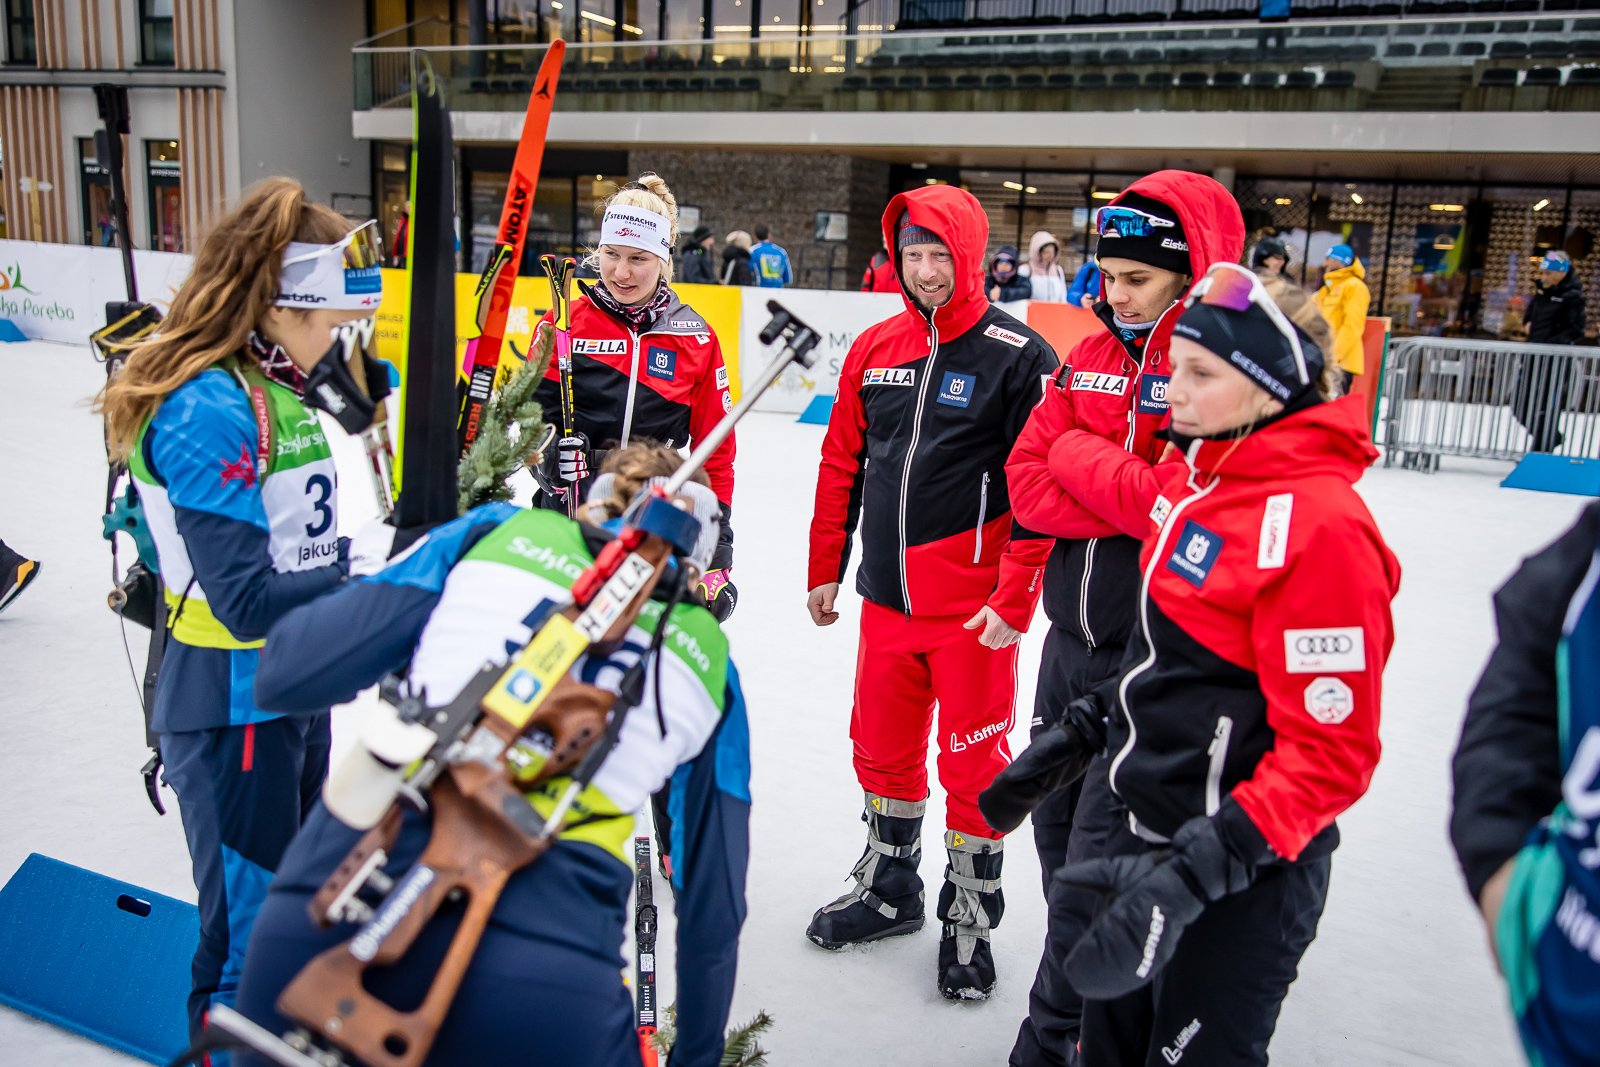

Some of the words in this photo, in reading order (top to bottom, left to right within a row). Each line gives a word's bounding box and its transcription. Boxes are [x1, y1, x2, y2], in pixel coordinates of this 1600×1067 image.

[504, 186, 527, 245] ATOM
[610, 213, 657, 228] STEINBACHER
[23, 297, 75, 321] Poręba
[672, 321, 701, 329] HELLA
[574, 340, 626, 353] HELLA
[829, 332, 853, 349] Mi
[999, 332, 1023, 345] Löffler
[649, 365, 673, 376] Husqvarna
[863, 368, 913, 385] HELLA
[1072, 373, 1126, 393] HELLA
[940, 392, 968, 403] Husqvarna
[1141, 399, 1172, 409] Husqvarn
[507, 536, 586, 582] Szkla
[709, 574, 721, 596] LEKI
[582, 559, 648, 635] HELLA
[966, 717, 1009, 745] Löffler
